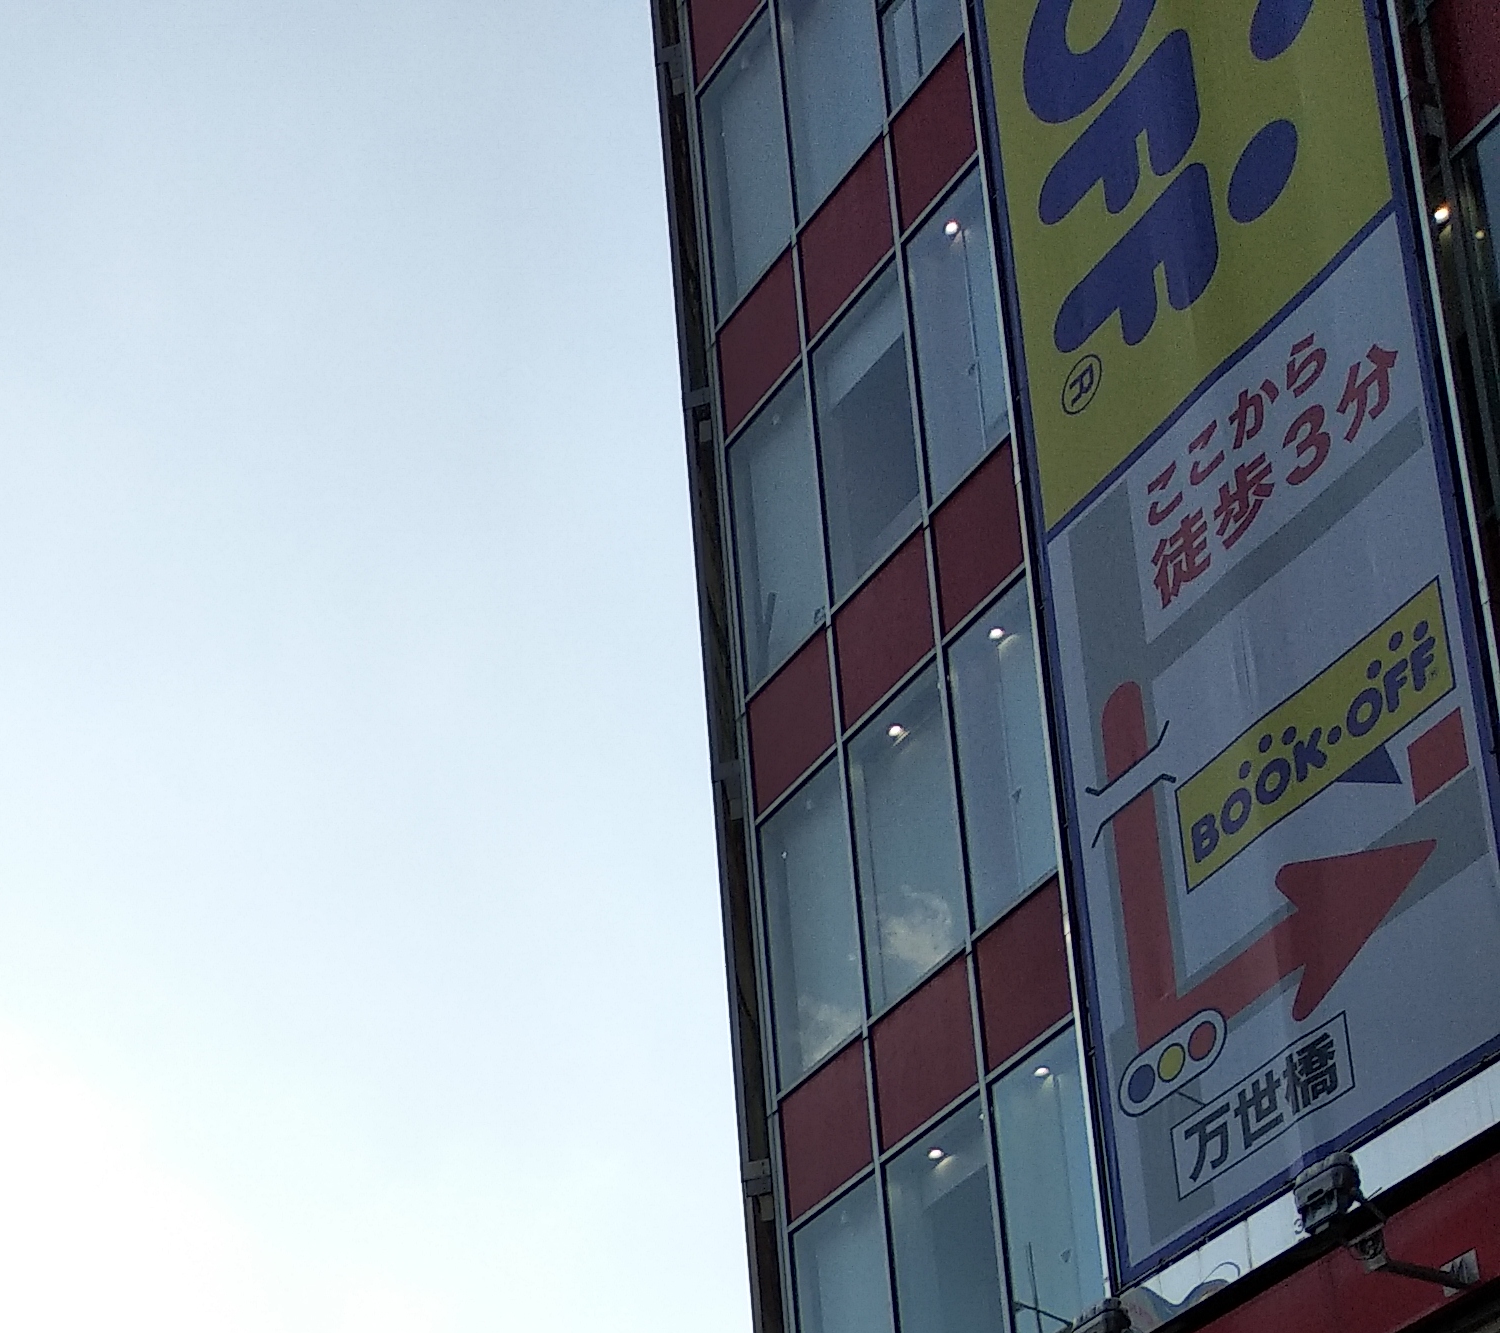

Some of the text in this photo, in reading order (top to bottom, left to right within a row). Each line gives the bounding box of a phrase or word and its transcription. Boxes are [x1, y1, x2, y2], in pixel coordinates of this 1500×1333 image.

[1147, 333, 1328, 527] ここから
[1151, 342, 1398, 610] 徒歩3分
[1185, 1033, 1338, 1184] 万世橋
